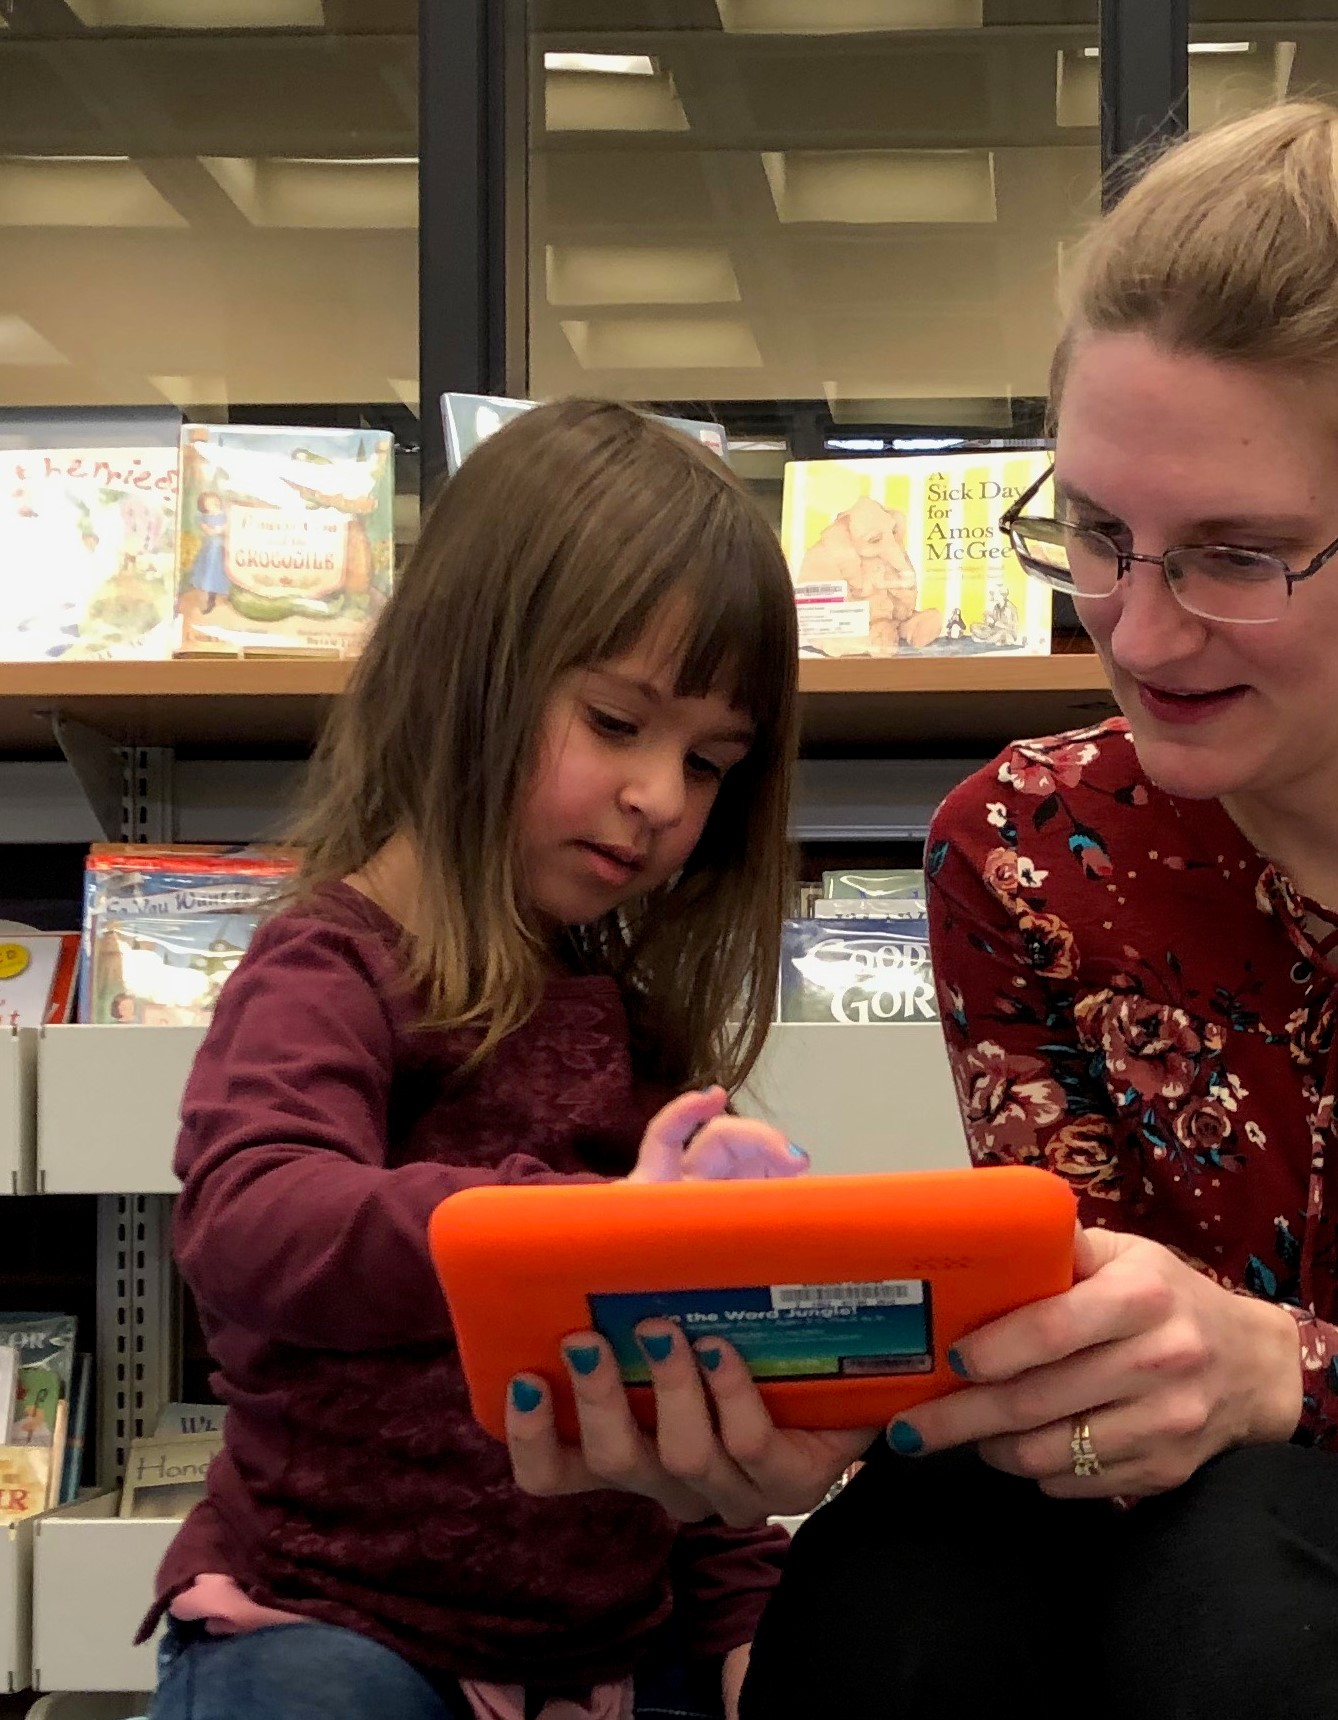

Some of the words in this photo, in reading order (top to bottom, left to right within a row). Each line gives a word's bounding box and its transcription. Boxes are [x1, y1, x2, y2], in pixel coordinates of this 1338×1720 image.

[928, 482, 974, 502] Sick
[979, 481, 1026, 500] Day
[927, 504, 952, 519] for
[927, 522, 994, 541] Amos
[235, 549, 335, 570] CROCODILE
[926, 542, 1013, 561] McGee
[831, 983, 937, 1023] GOR
[686, 1311, 719, 1323] the
[724, 1308, 779, 1321] Word
[788, 1304, 857, 1320] Jungle!
